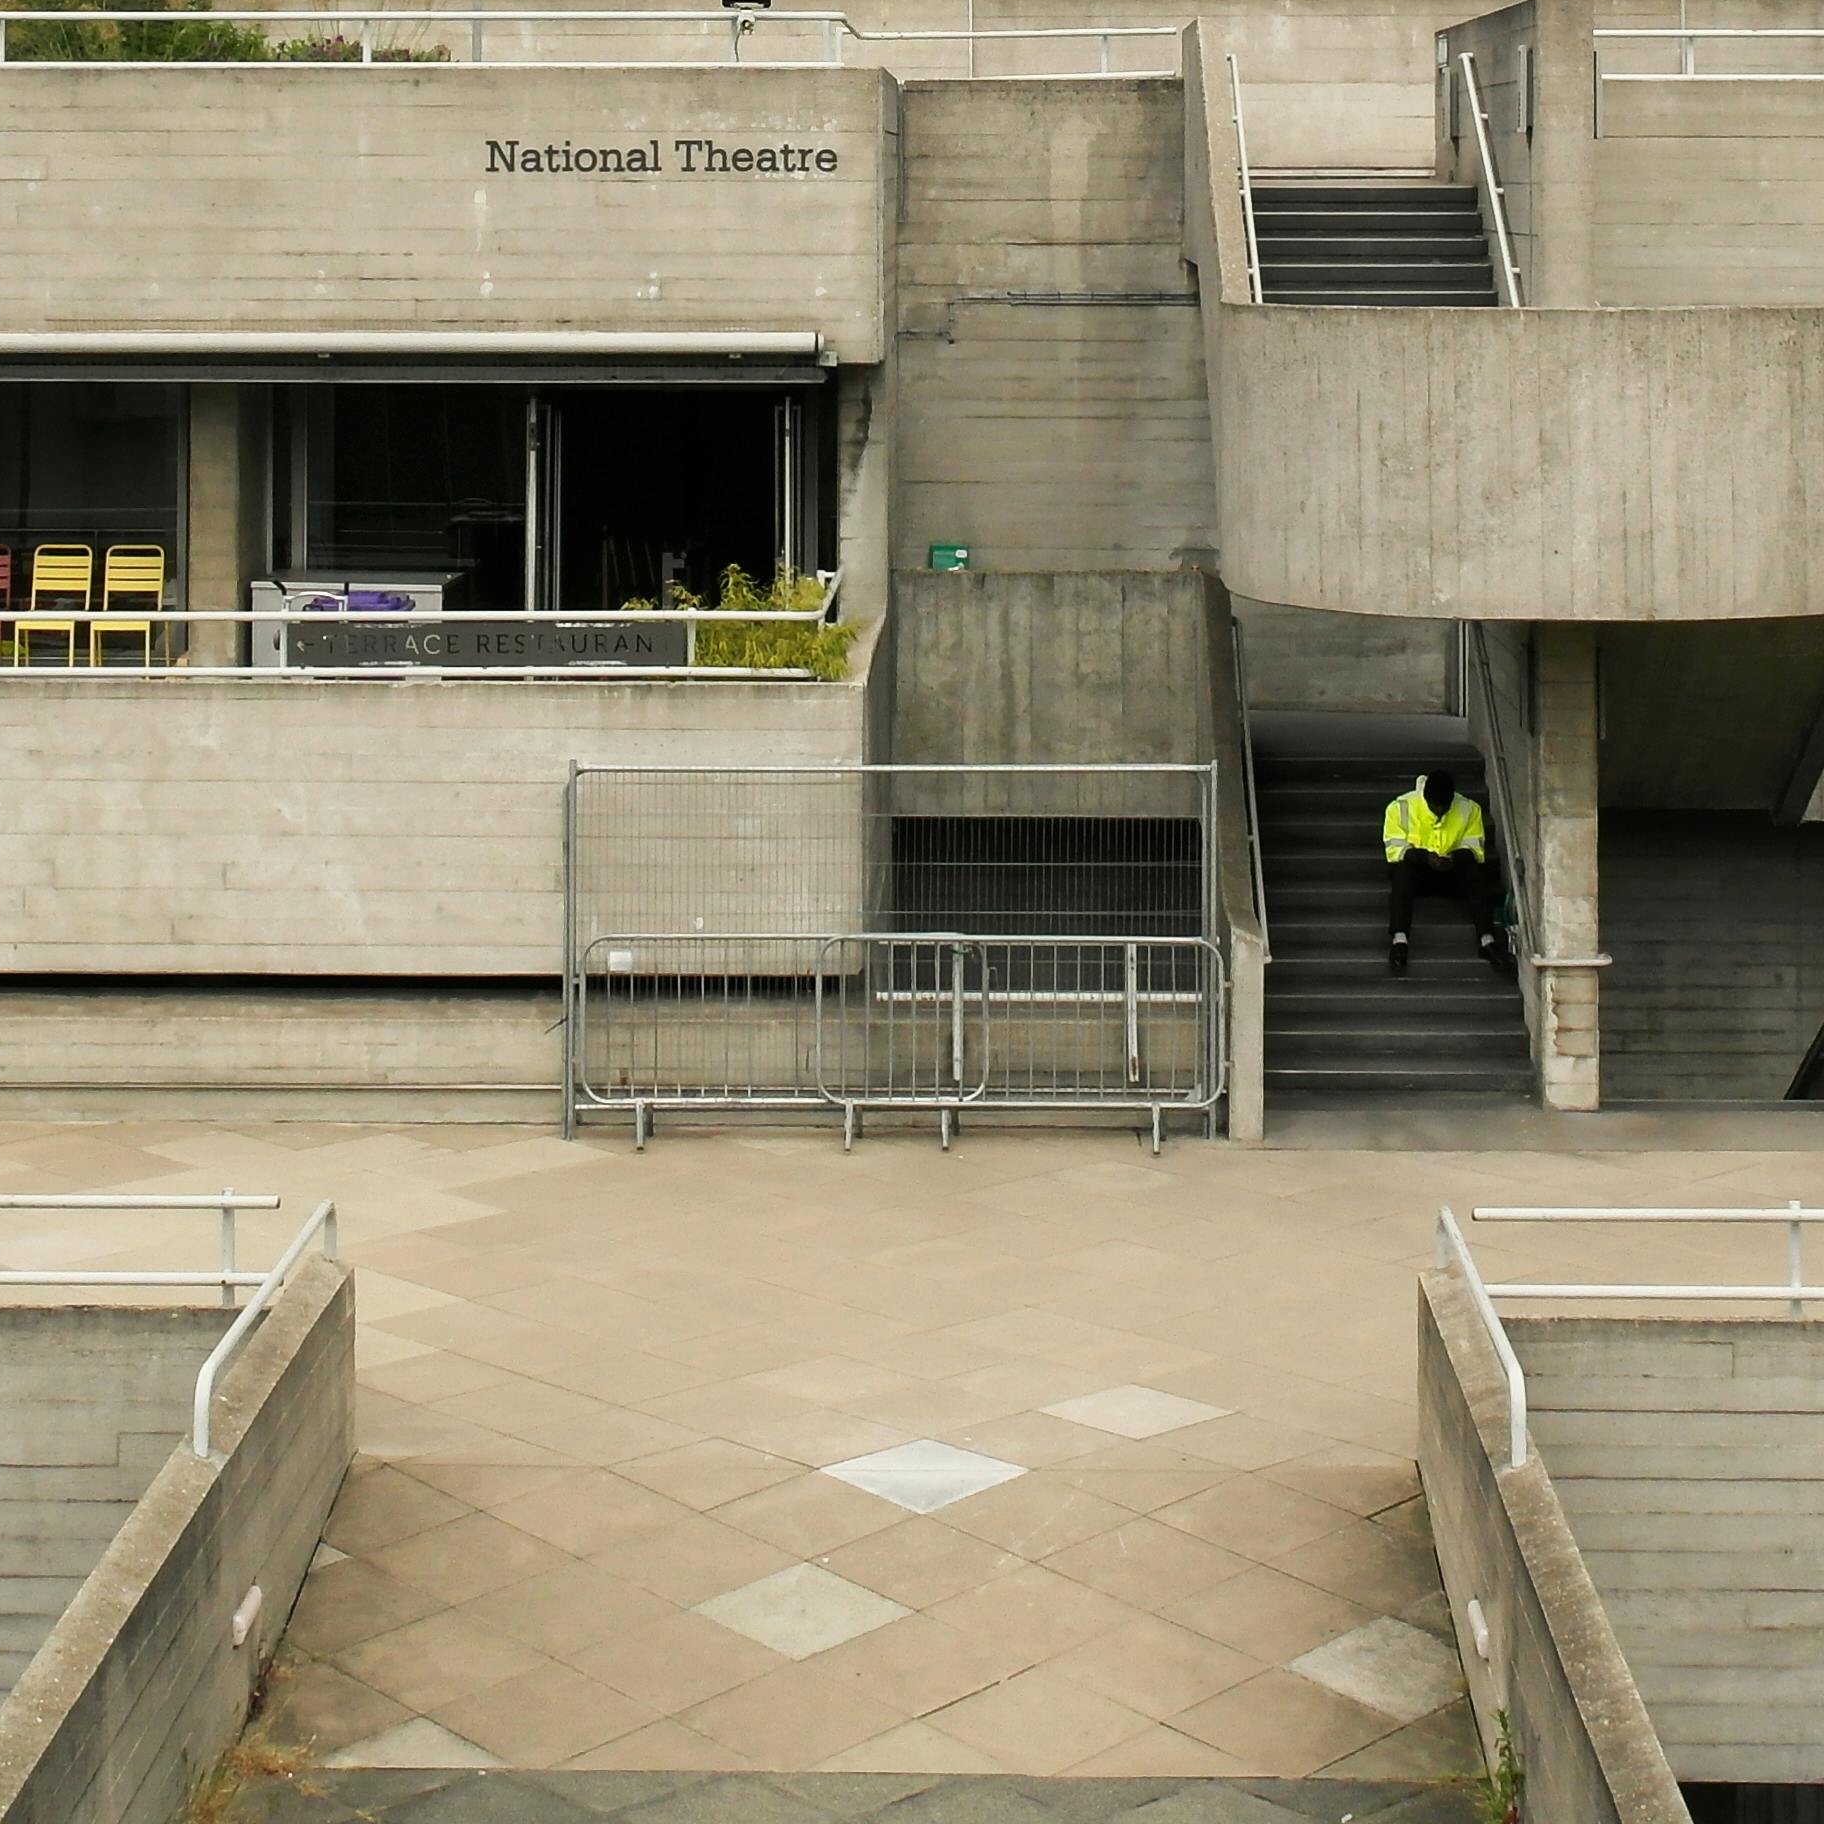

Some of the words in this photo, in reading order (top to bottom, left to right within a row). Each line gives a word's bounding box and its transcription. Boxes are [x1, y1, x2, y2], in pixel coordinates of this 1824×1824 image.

[485, 139, 662, 173] National
[675, 139, 838, 173] Theatre
[323, 633, 460, 655] TERRACE
[477, 633, 673, 654] RESTAURAN
